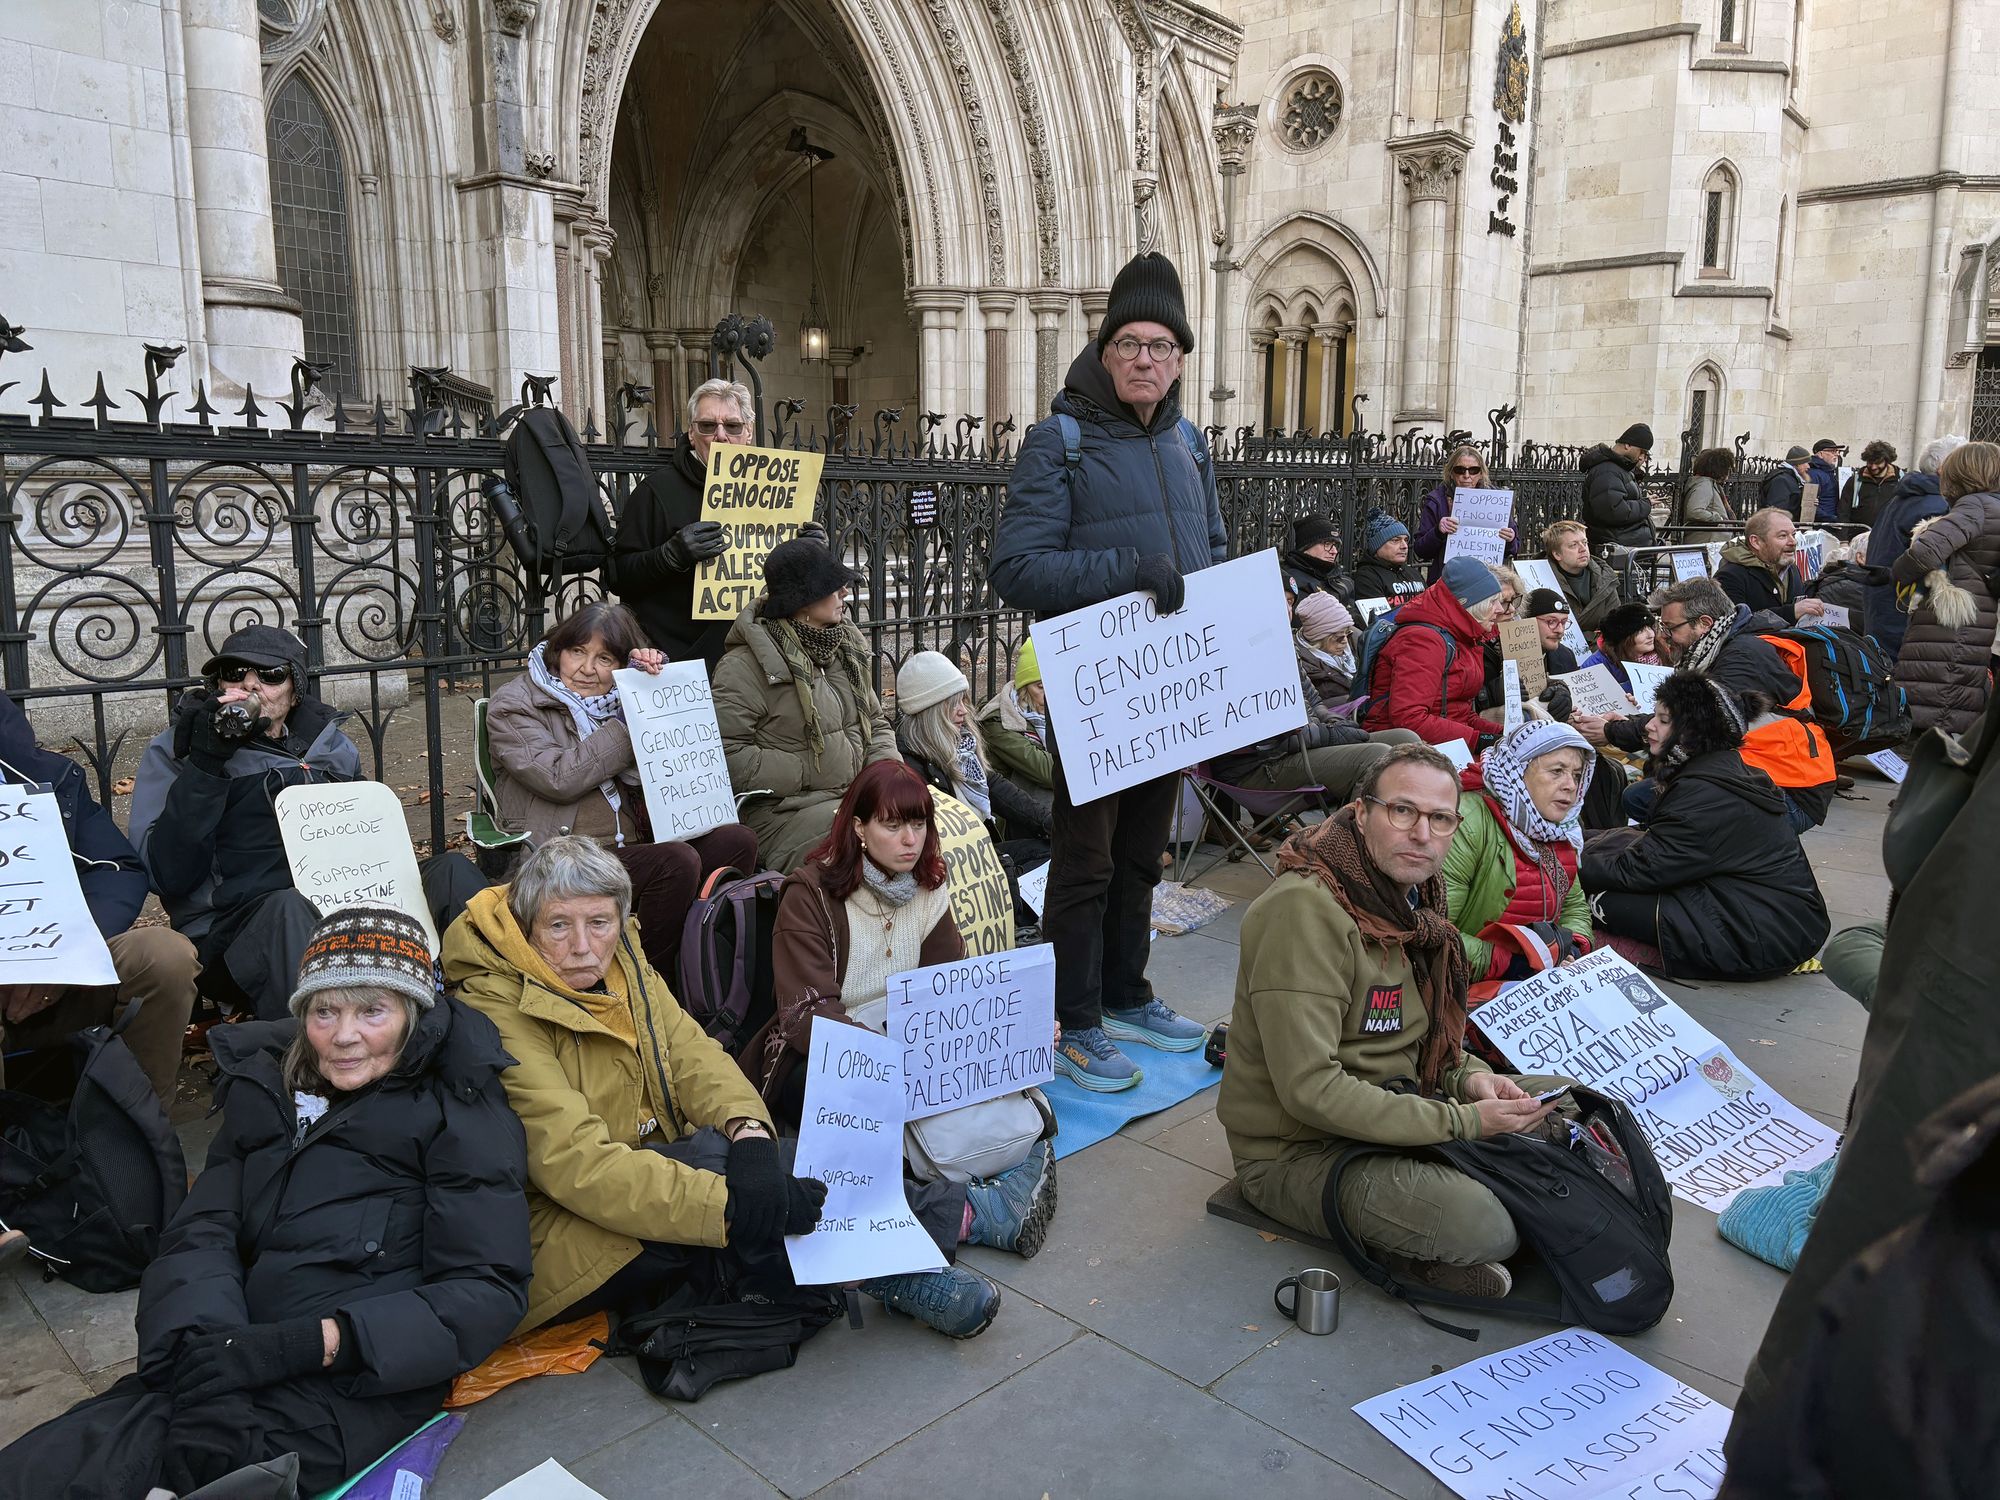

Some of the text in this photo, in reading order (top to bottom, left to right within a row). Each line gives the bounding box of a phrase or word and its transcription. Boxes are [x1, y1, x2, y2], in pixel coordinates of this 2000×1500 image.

[1498, 122, 1515, 148] The
[1494, 144, 1518, 173] Royal
[1491, 167, 1518, 195] Courts
[1497, 194, 1509, 213] of
[1487, 211, 1516, 238] Justice
[713, 452, 800, 482] I OPPOSE
[707, 483, 797, 509] GENOCIDE
[1455, 494, 1510, 506] I OPPOSE
[1455, 509, 1508, 522] GENOCIDE
[1449, 540, 1503, 553] PALESTINE
[1464, 528, 1498, 538] SUPPOR
[1051, 597, 1188, 655] I OPPO
[1074, 624, 1221, 706] GENOCIDE
[632, 679, 712, 714] I OPPOSE
[1080, 666, 1228, 742] I SUPPORT
[641, 722, 720, 754] GENOCIDE
[1089, 684, 1297, 786] PALESTINE ACTION
[644, 745, 725, 784] I SUPPORT
[660, 770, 731, 805] PALESTINE
[278, 798, 359, 821] I OPPOSE
[671, 796, 735, 834] ACTION
[300, 818, 383, 842] GENOCIDE
[295, 855, 390, 886] I SUPPORT
[950, 874, 1013, 932] ESTINE
[900, 959, 1012, 1005] I OPPOSE
[1548, 970, 1564, 984] OF
[1564, 952, 1613, 977] SURVIVORS
[904, 989, 1022, 1044] GENOCIDE
[1369, 1008, 1380, 1019] IN
[1497, 1005, 1545, 1039] JAPESE
[1580, 979, 1593, 994] &
[1365, 1018, 1401, 1032] NAAM.
[924, 1024, 1016, 1069] SUPPORT
[1064, 1044, 1090, 1069] HOKA
[1553, 1010, 1676, 1087] ENENTANG
[822, 1042, 896, 1083] I OPPOSE
[1000, 1044, 1053, 1084] ACTION
[1602, 1046, 1700, 1108] NOSIDA
[816, 1107, 883, 1133] GENOCIDE
[822, 1169, 874, 1187] SUPPORT
[815, 1215, 917, 1232] ESTINE ACTION
[1422, 1380, 1488, 1414] TA
[1479, 1333, 1607, 1391] KONTRA
[1534, 1456, 1609, 1486] TA
